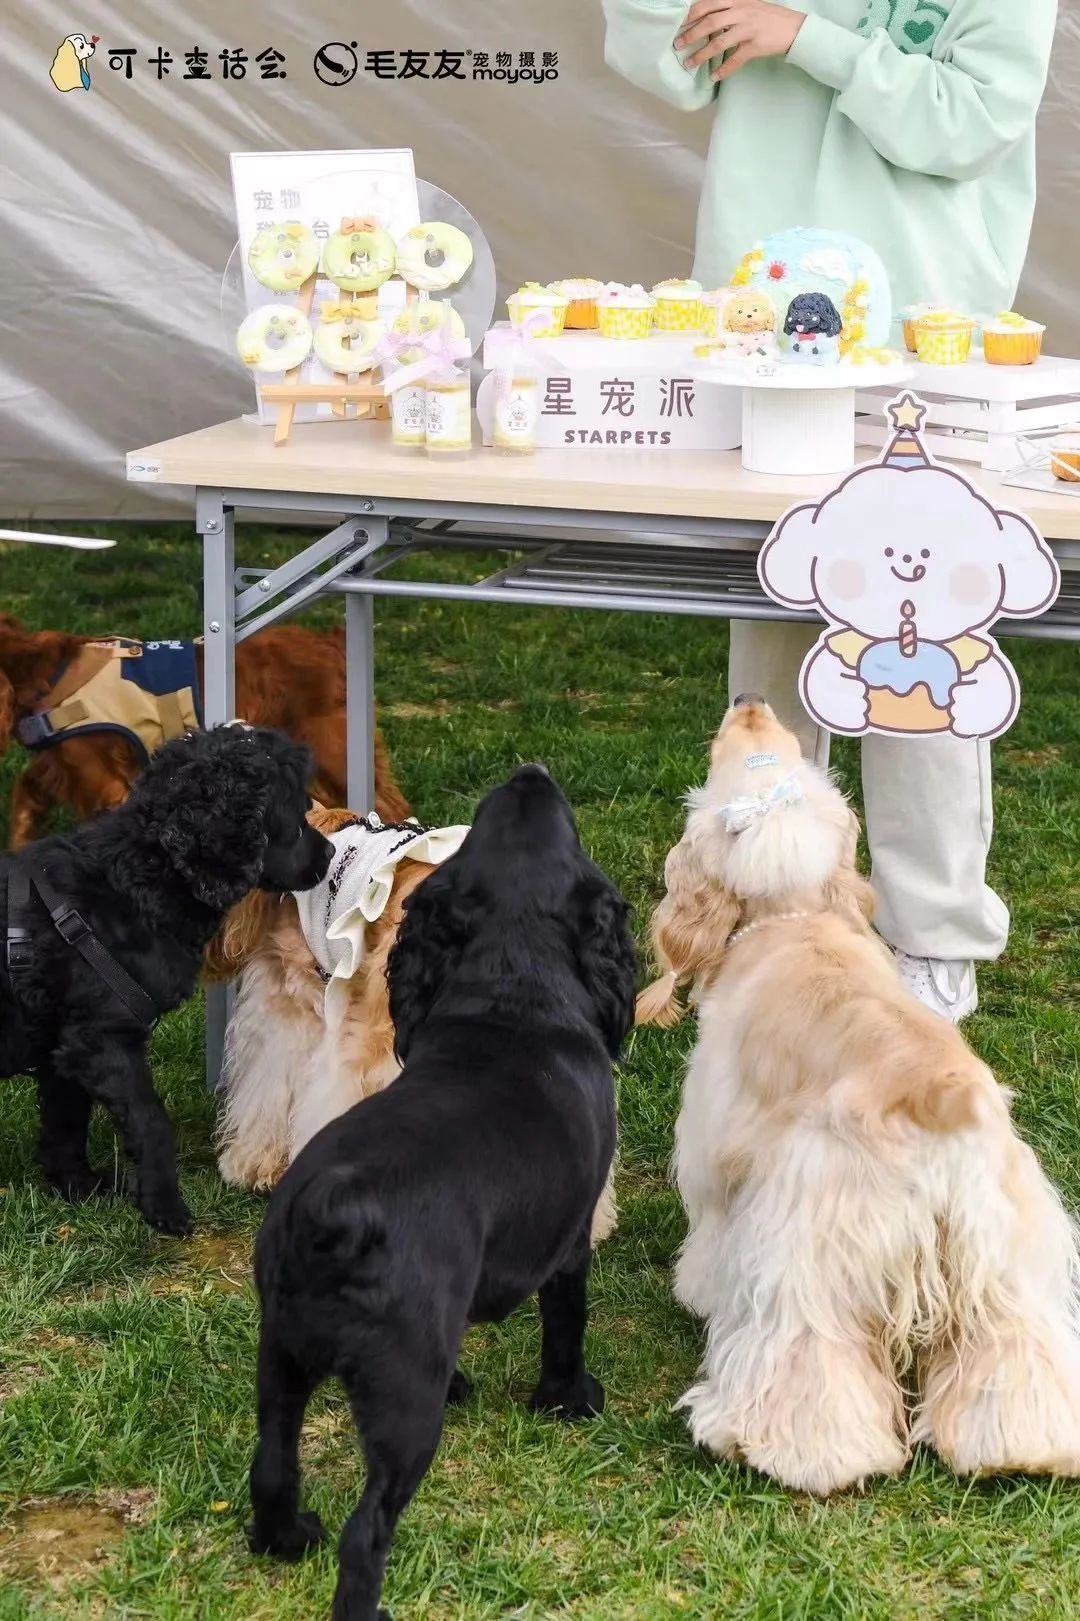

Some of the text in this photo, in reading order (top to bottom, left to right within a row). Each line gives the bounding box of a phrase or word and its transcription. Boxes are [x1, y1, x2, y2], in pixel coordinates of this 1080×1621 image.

[253, 189, 300, 211] 宠物
[540, 377, 696, 417] 星宠派
[564, 429, 671, 445] STARPETS
